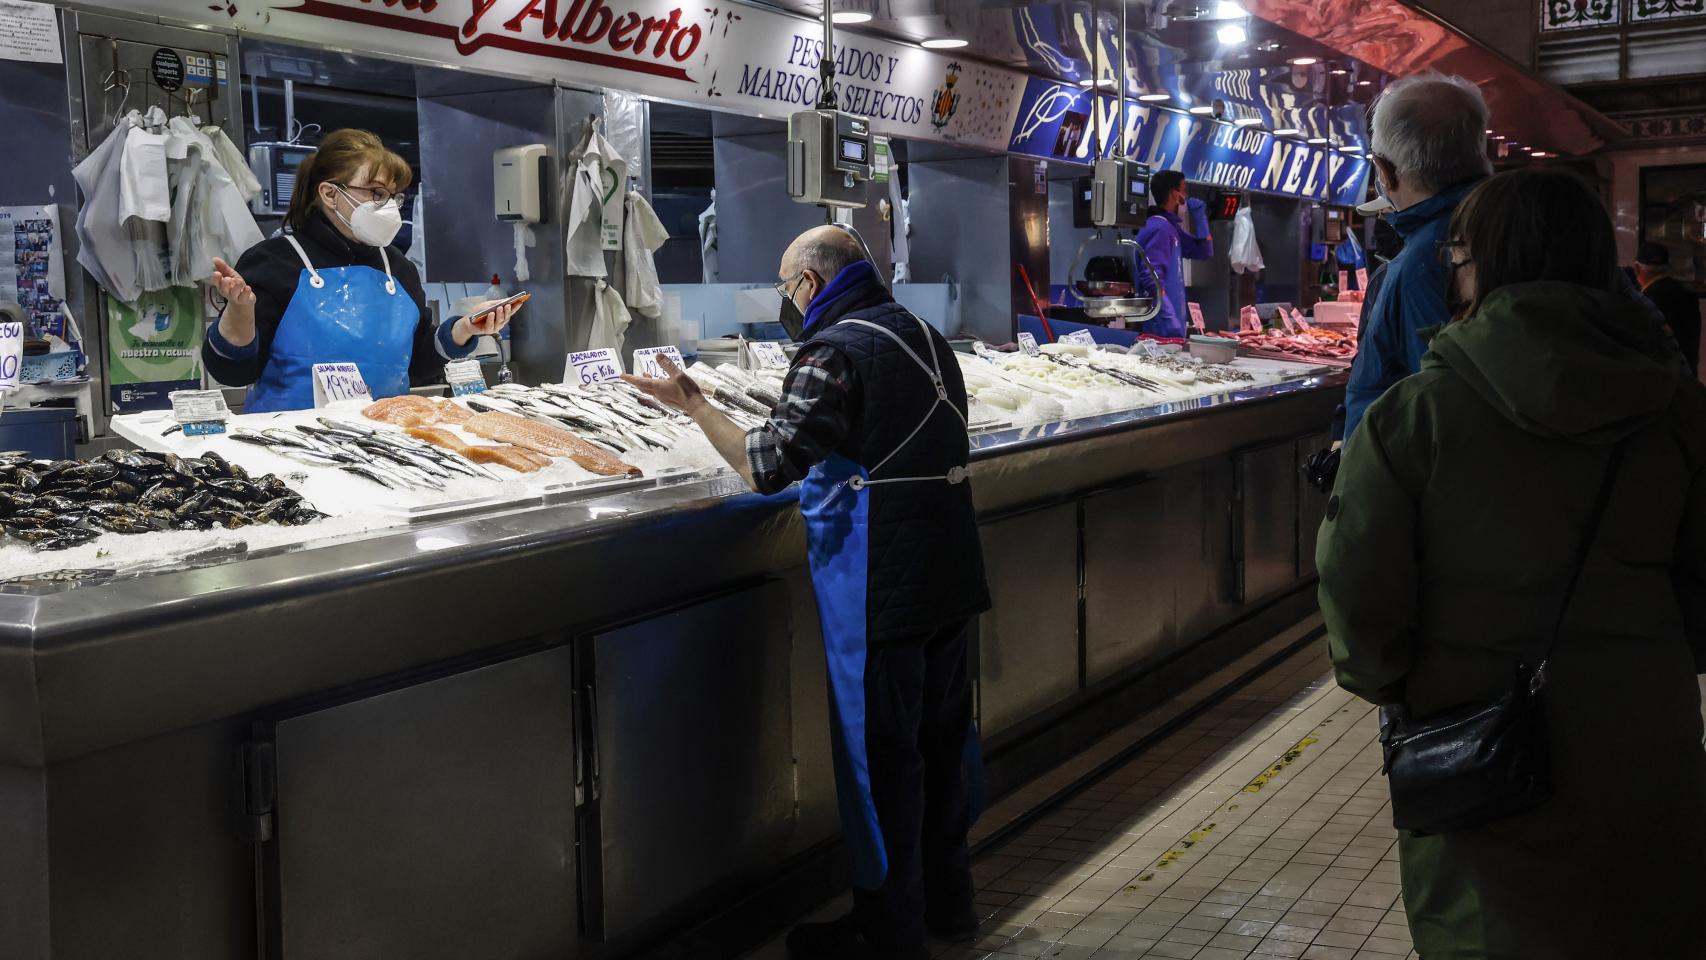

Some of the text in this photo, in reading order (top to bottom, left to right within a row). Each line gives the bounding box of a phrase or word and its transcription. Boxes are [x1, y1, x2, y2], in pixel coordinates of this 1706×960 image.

[503, 0, 702, 62] Alberto
[788, 34, 899, 84] PESADOS Y
[842, 84, 924, 124] SELECTOS
[1076, 96, 1344, 198] NELY PESCADOS NELY
[120, 347, 159, 359] nuestra
